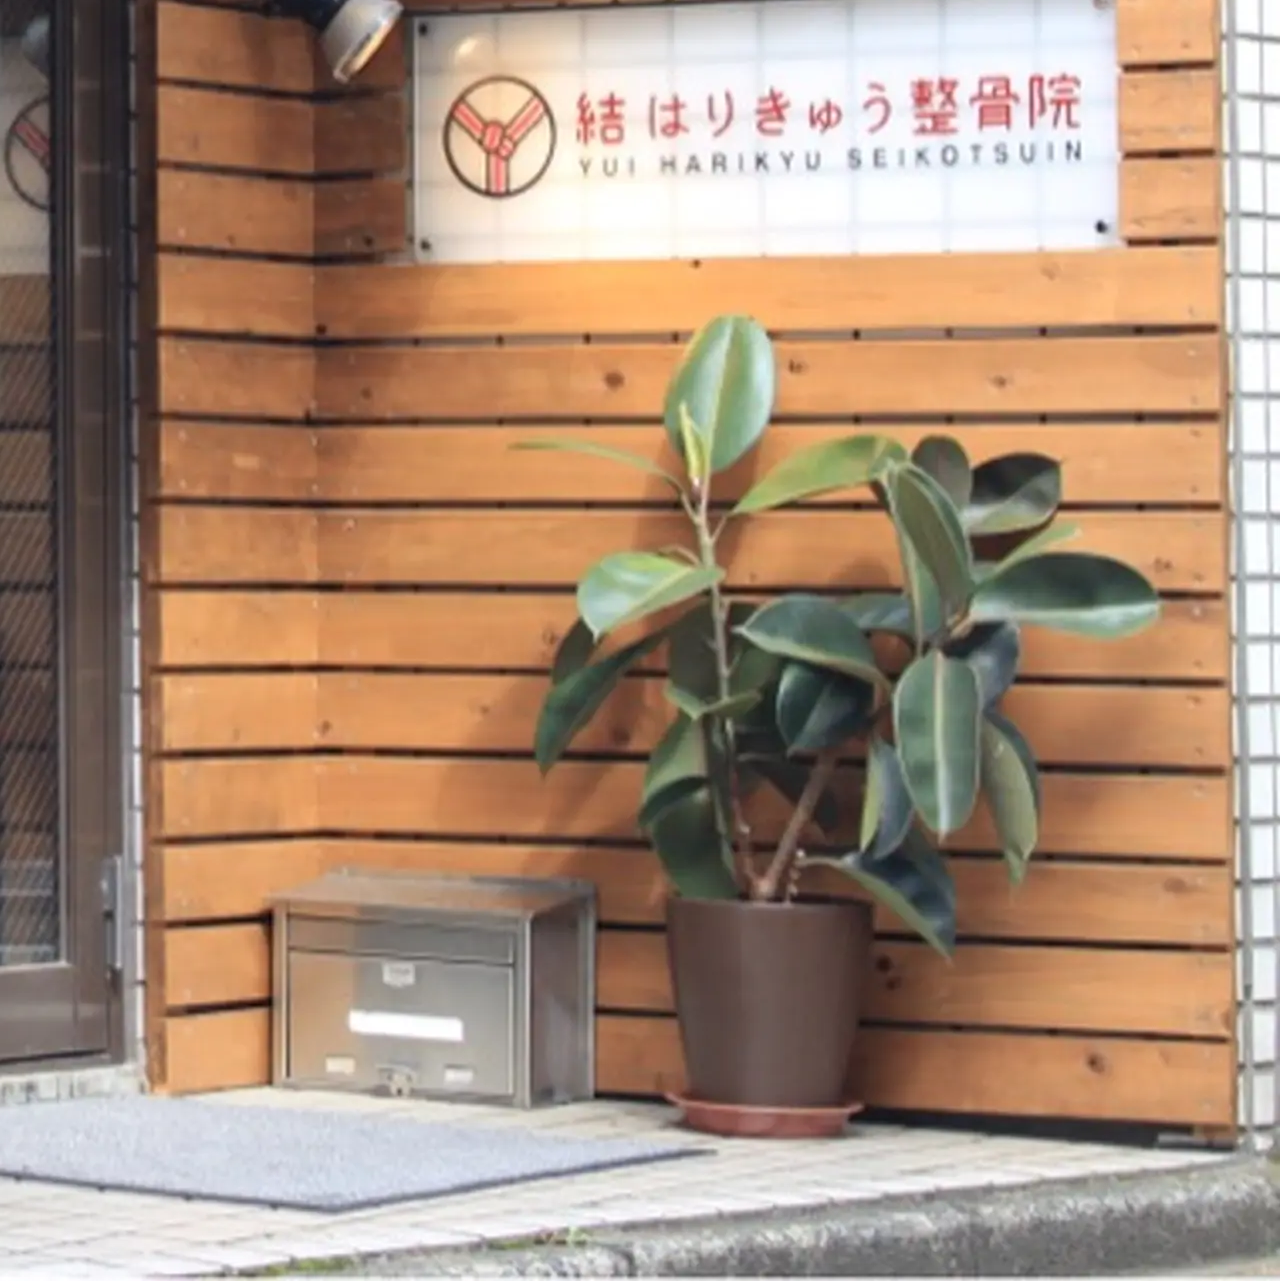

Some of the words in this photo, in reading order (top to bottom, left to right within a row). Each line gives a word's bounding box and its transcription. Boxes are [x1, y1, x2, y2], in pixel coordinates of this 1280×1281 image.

[579, 154, 637, 178] YUI
[659, 149, 824, 175] HARIKYU
[846, 140, 1084, 169] SEIKOTSUIN
